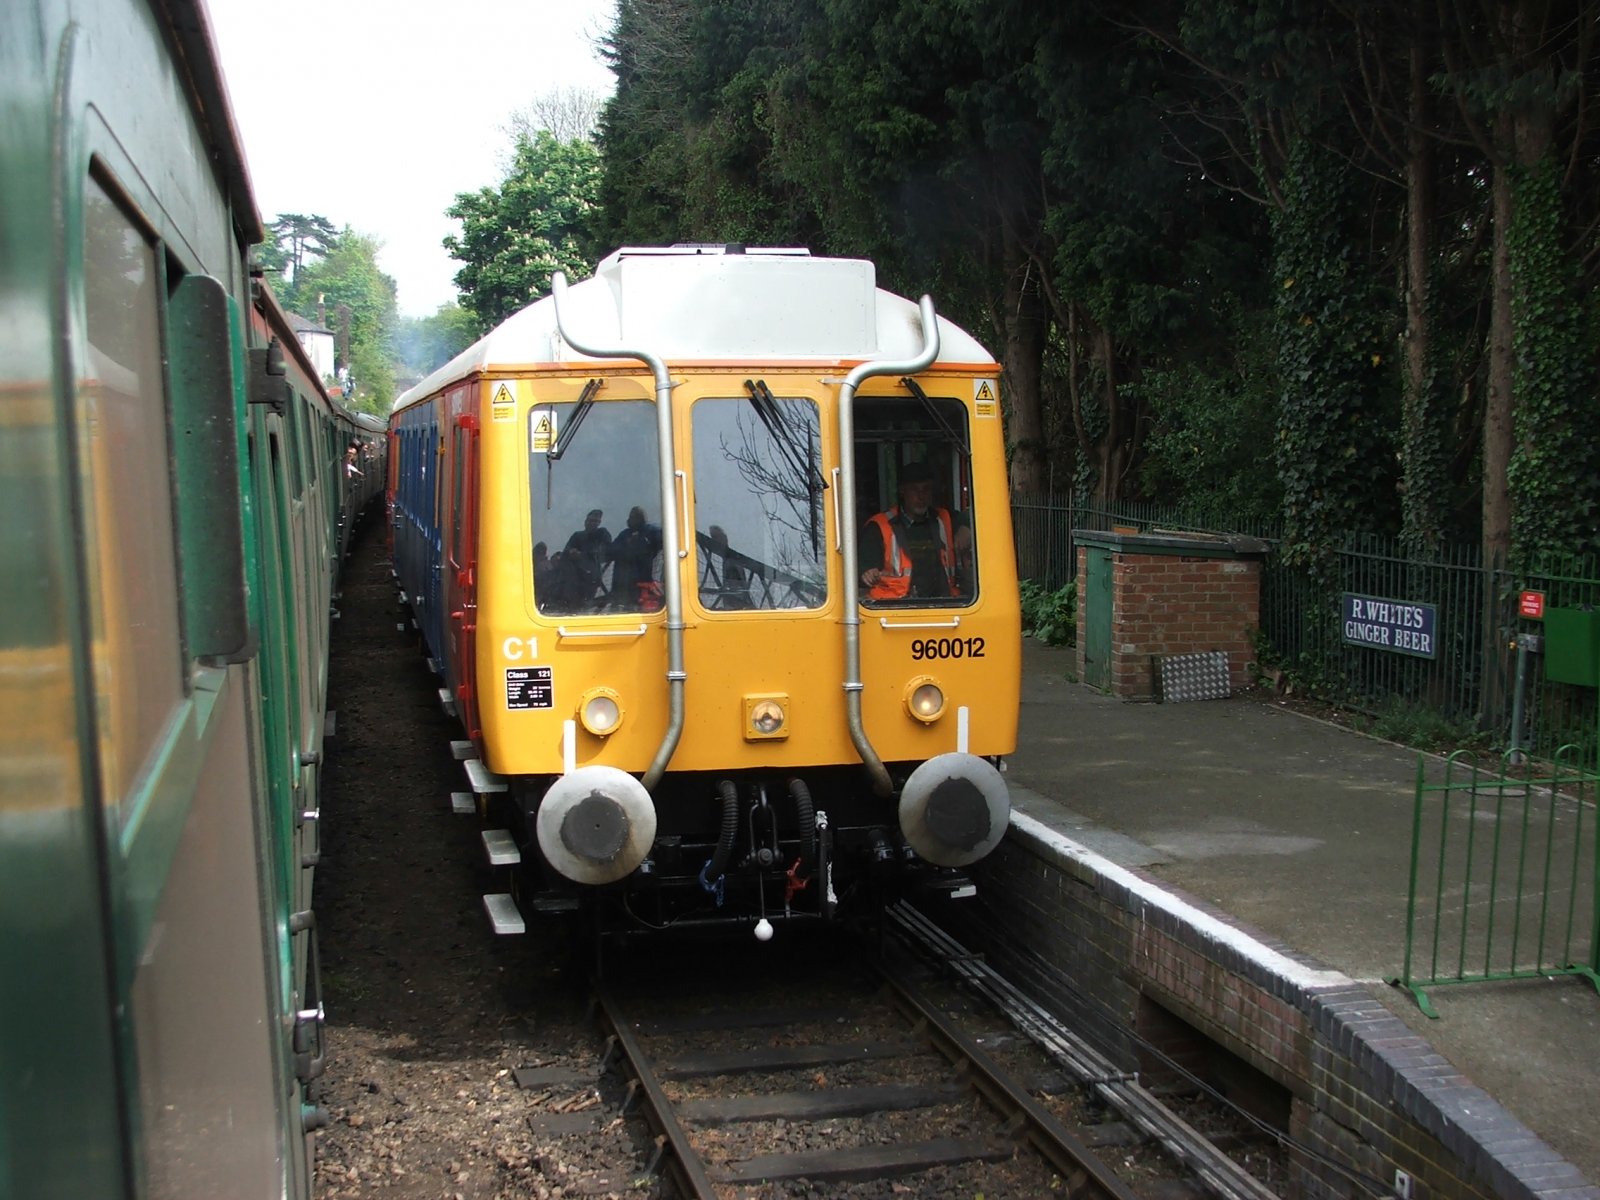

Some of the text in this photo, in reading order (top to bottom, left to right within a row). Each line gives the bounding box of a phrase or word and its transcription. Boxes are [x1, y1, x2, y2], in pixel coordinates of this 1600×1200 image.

[503, 636, 539, 661] C1
[911, 637, 985, 660] 960012
[1345, 620, 1431, 653] GINGER BEER
[507, 670, 551, 679] Class 121
